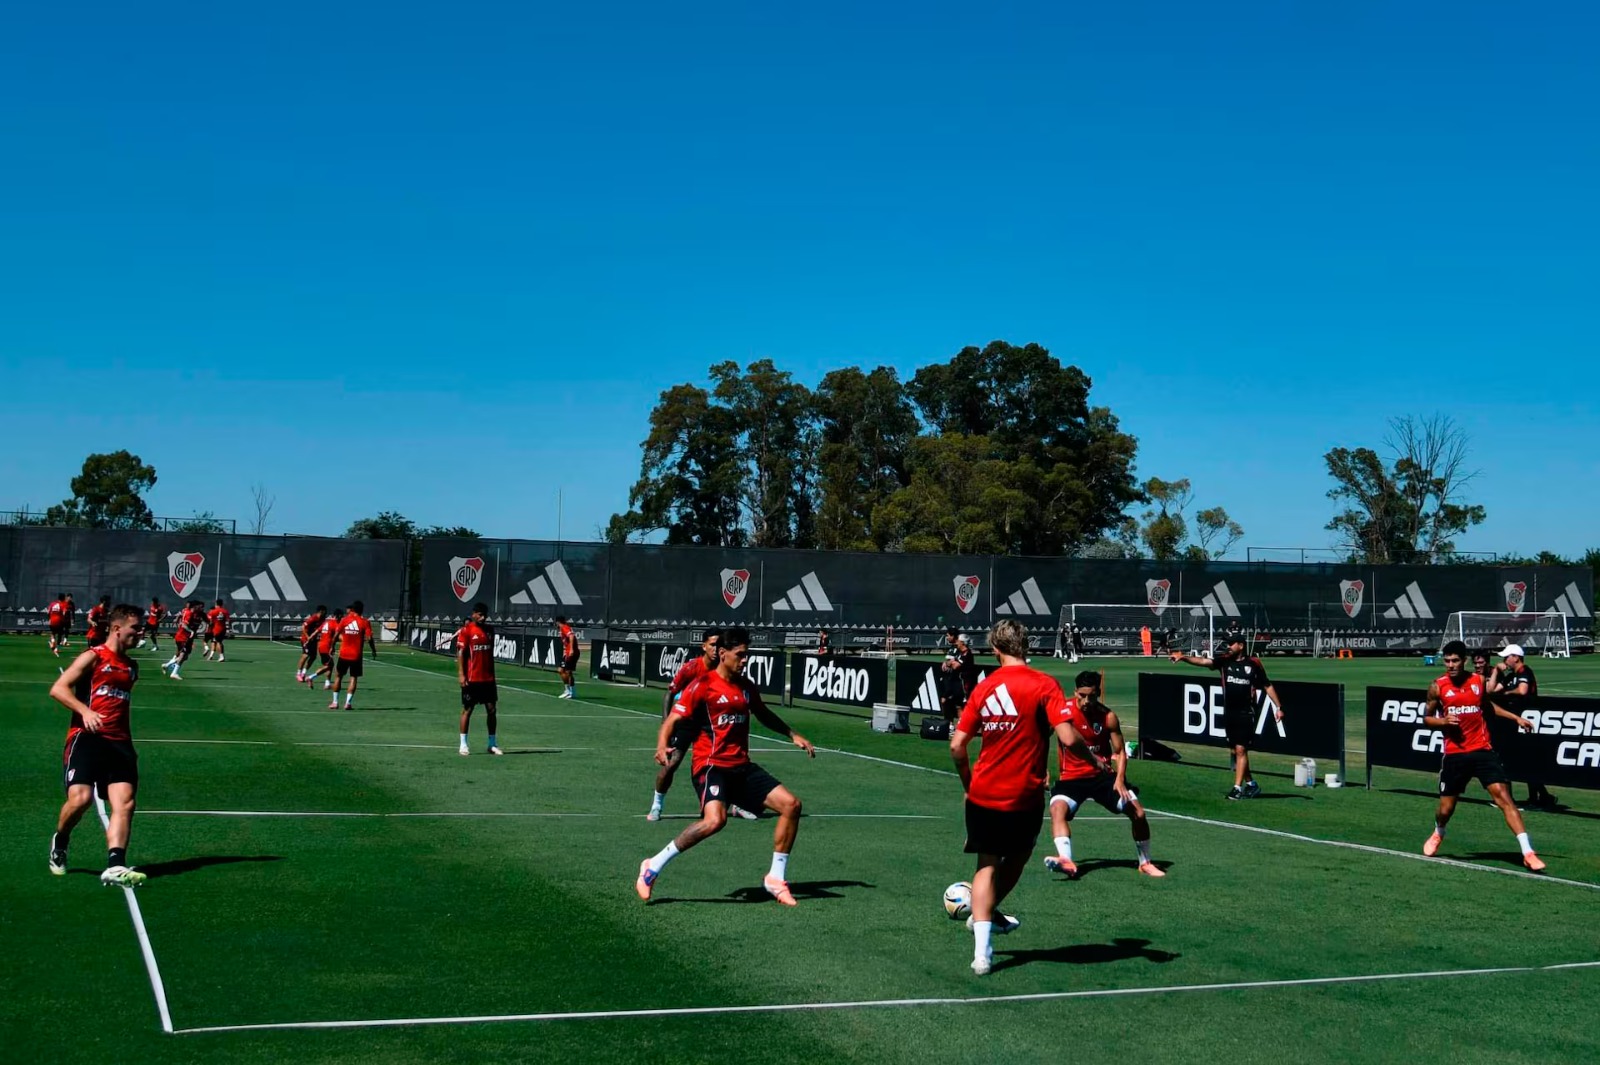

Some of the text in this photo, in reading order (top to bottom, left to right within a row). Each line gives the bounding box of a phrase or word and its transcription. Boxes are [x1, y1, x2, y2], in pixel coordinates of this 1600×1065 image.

[641, 630, 674, 640] avalian
[1345, 638, 1377, 648] NEGRA
[493, 633, 517, 660] Betano
[609, 646, 630, 665] avalian
[802, 656, 870, 702] Betano
[1411, 729, 1444, 753] CA
